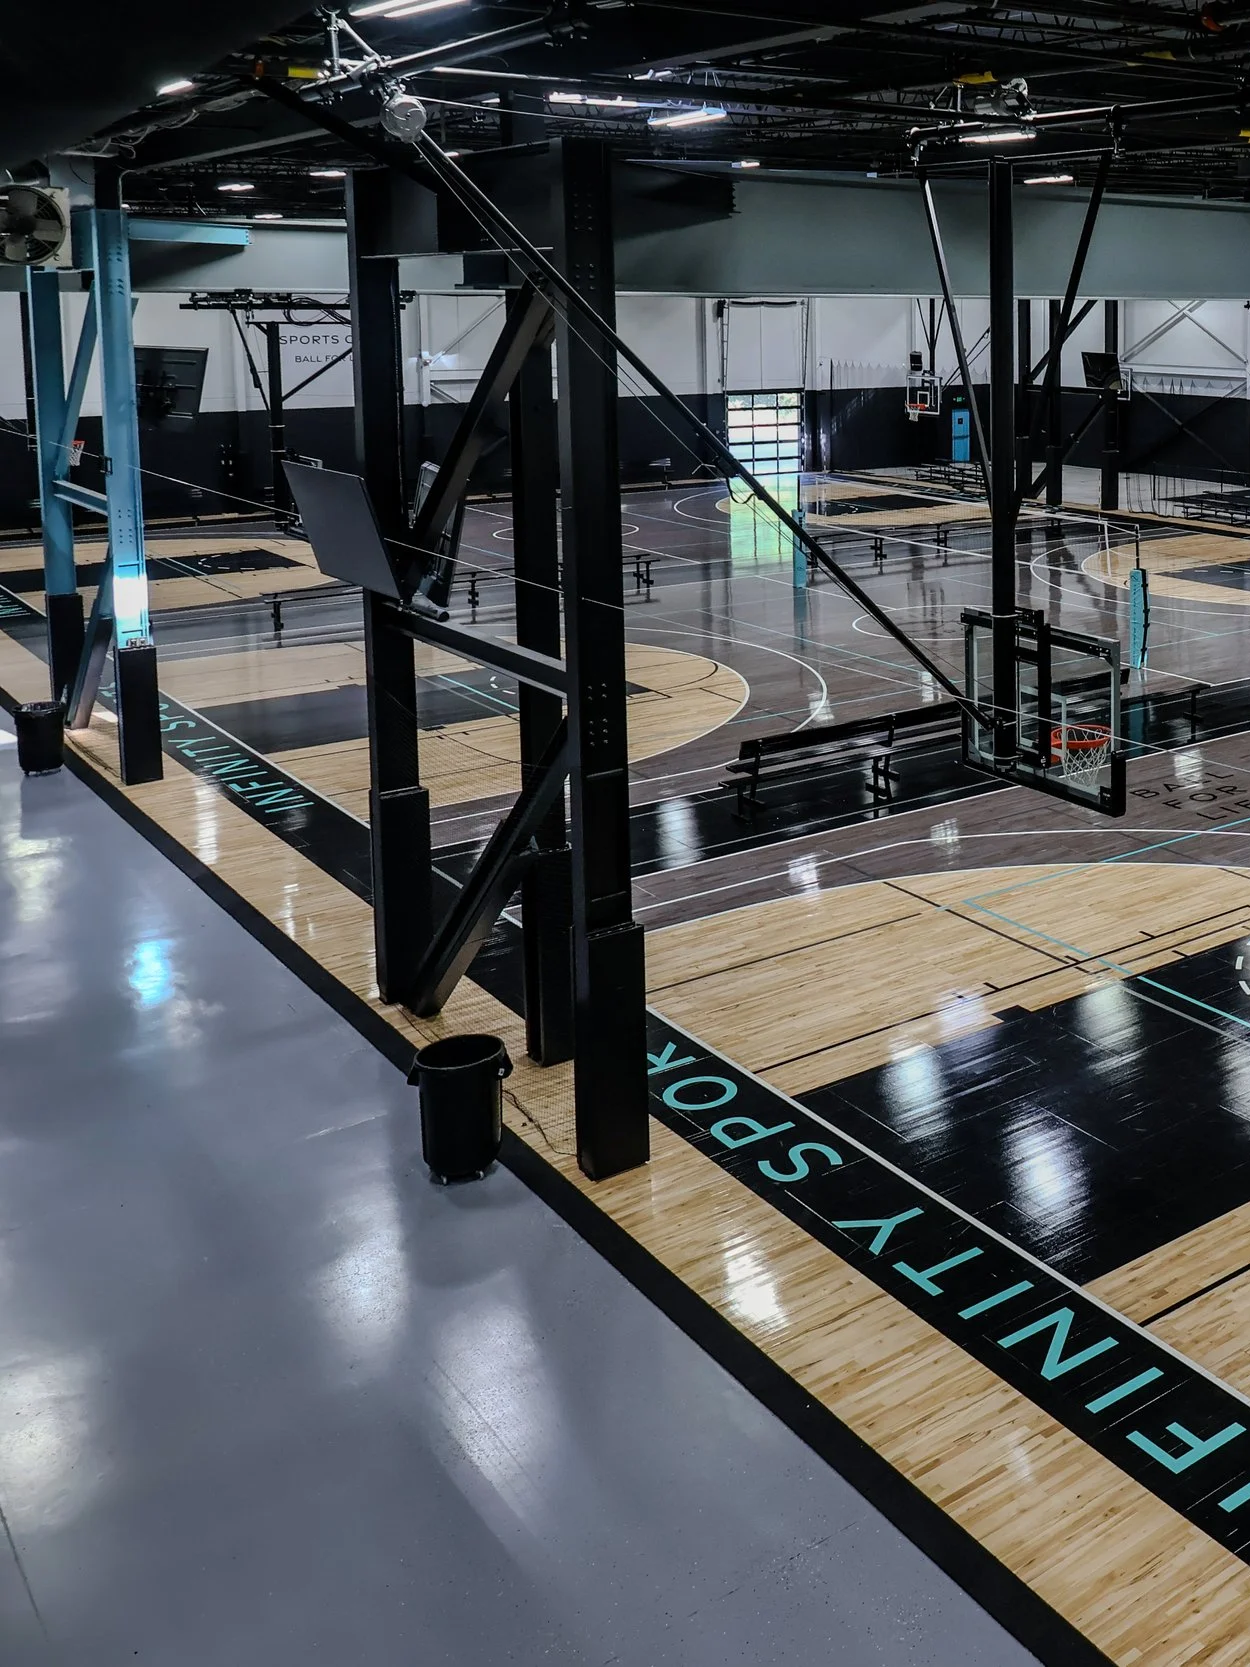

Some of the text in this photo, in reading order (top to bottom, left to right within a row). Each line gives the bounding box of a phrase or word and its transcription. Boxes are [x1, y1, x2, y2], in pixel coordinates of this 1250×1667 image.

[279, 334, 340, 345] SPORTS
[294, 354, 322, 363] BALL
[168, 736, 315, 813] INFINITY
[1130, 772, 1234, 799] BALL
[1162, 785, 1248, 810] FOR
